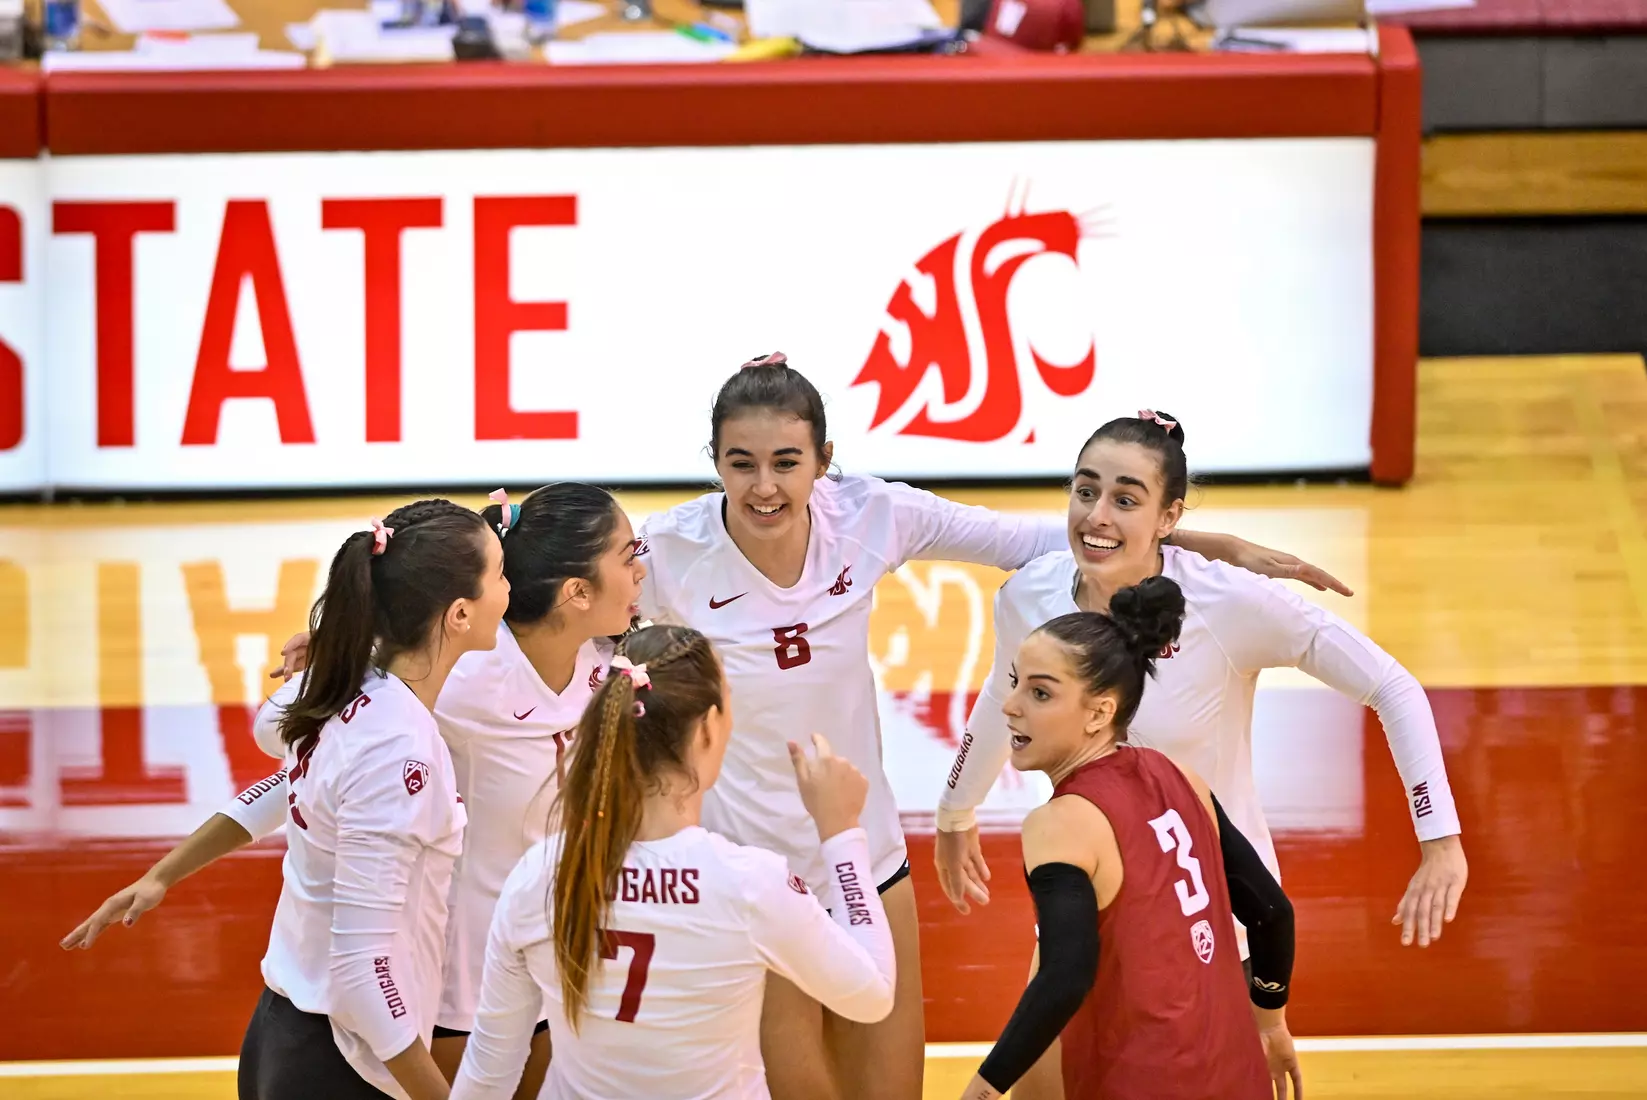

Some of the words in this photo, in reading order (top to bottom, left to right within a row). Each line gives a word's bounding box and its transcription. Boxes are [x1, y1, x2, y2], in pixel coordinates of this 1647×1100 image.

[0, 194, 579, 452] TATE
[771, 622, 812, 671] 8
[408, 778, 421, 792] 12
[1412, 780, 1433, 819] WSU
[606, 867, 700, 905] GARS
[835, 861, 873, 926] COUGARS
[1147, 808, 1210, 917] 3
[373, 955, 407, 1020] COUGARS
[595, 927, 656, 1023] 7
